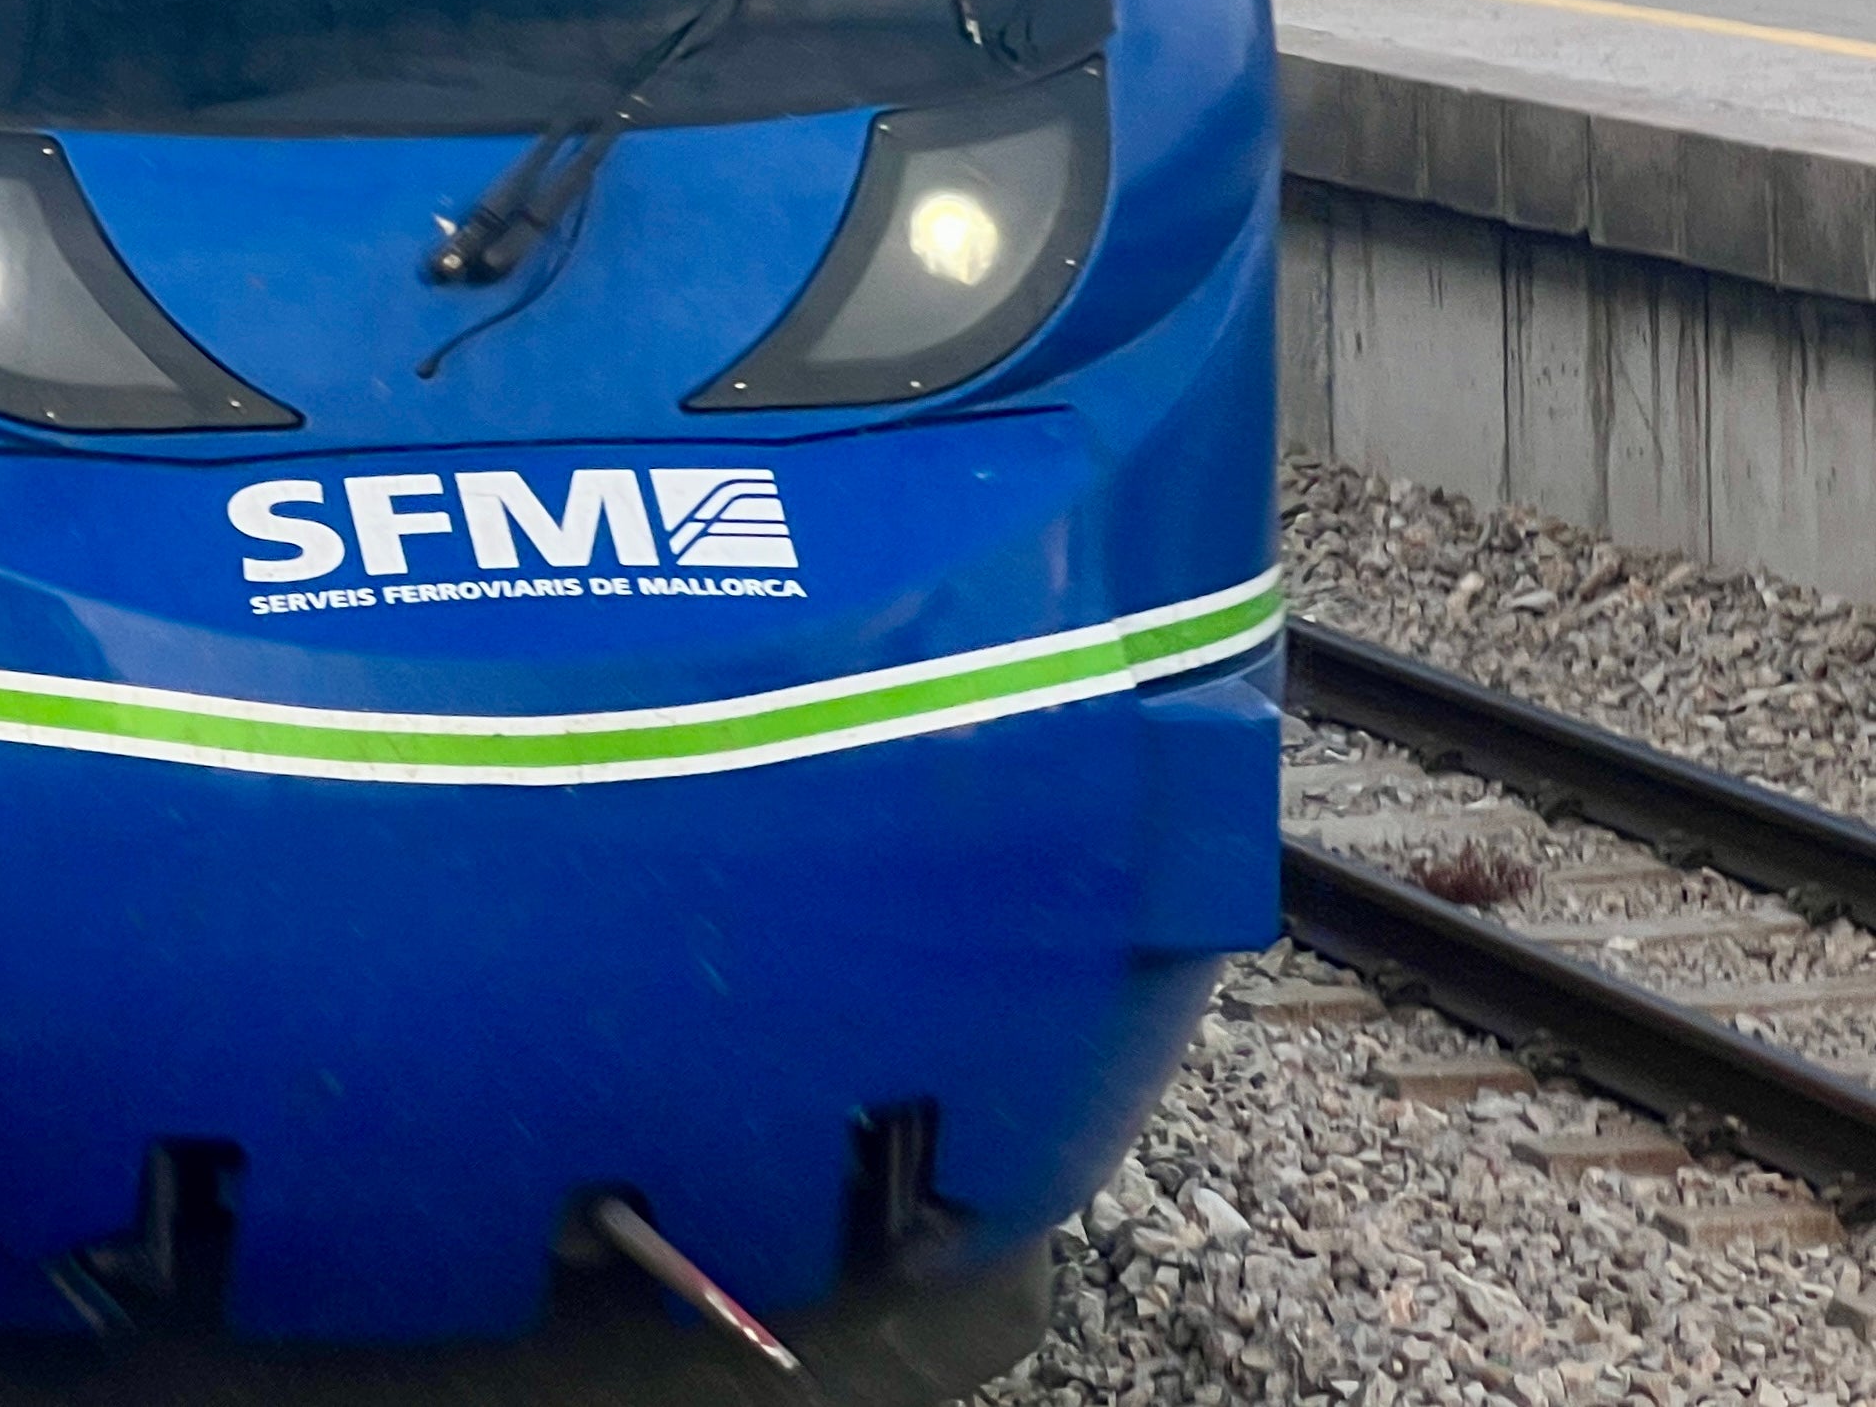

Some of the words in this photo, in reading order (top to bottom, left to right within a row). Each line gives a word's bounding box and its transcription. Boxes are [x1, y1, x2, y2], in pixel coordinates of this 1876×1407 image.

[227, 468, 661, 583] SFM
[250, 588, 376, 614] SERVEIS
[382, 577, 583, 605] FERROVIARIS
[591, 577, 633, 597] DE
[638, 577, 808, 599] MALLORCA
